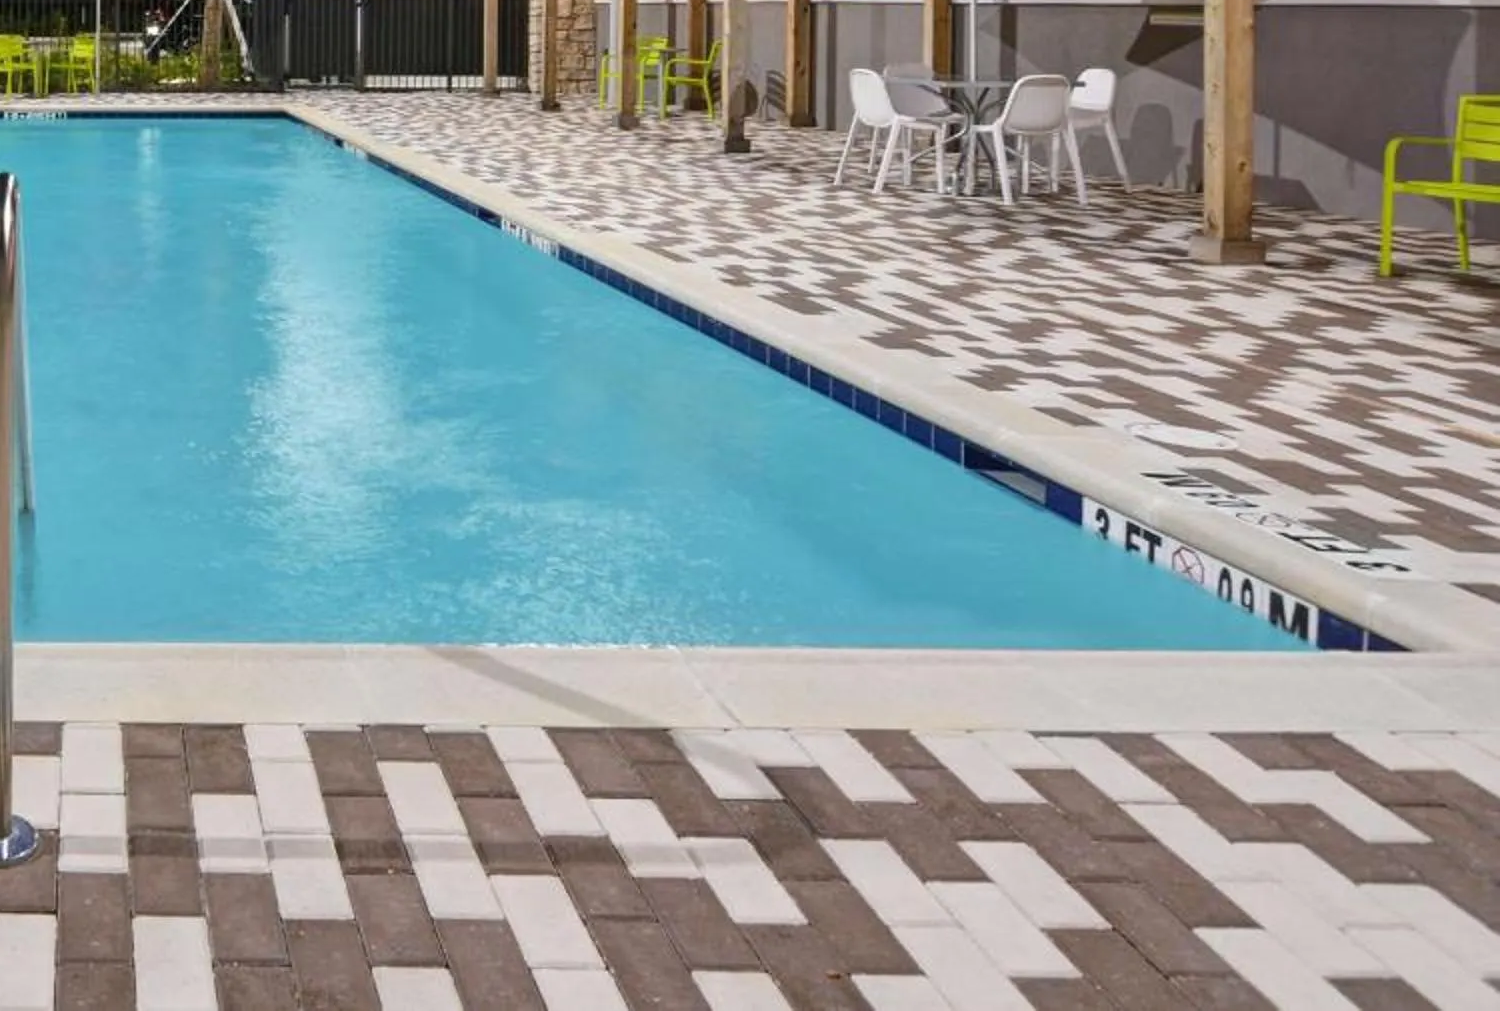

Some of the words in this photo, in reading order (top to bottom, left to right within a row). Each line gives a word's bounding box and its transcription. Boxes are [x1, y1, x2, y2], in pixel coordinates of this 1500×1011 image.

[1095, 508, 1110, 540] 3
[1125, 520, 1163, 564] FT
[1269, 590, 1309, 642] M
